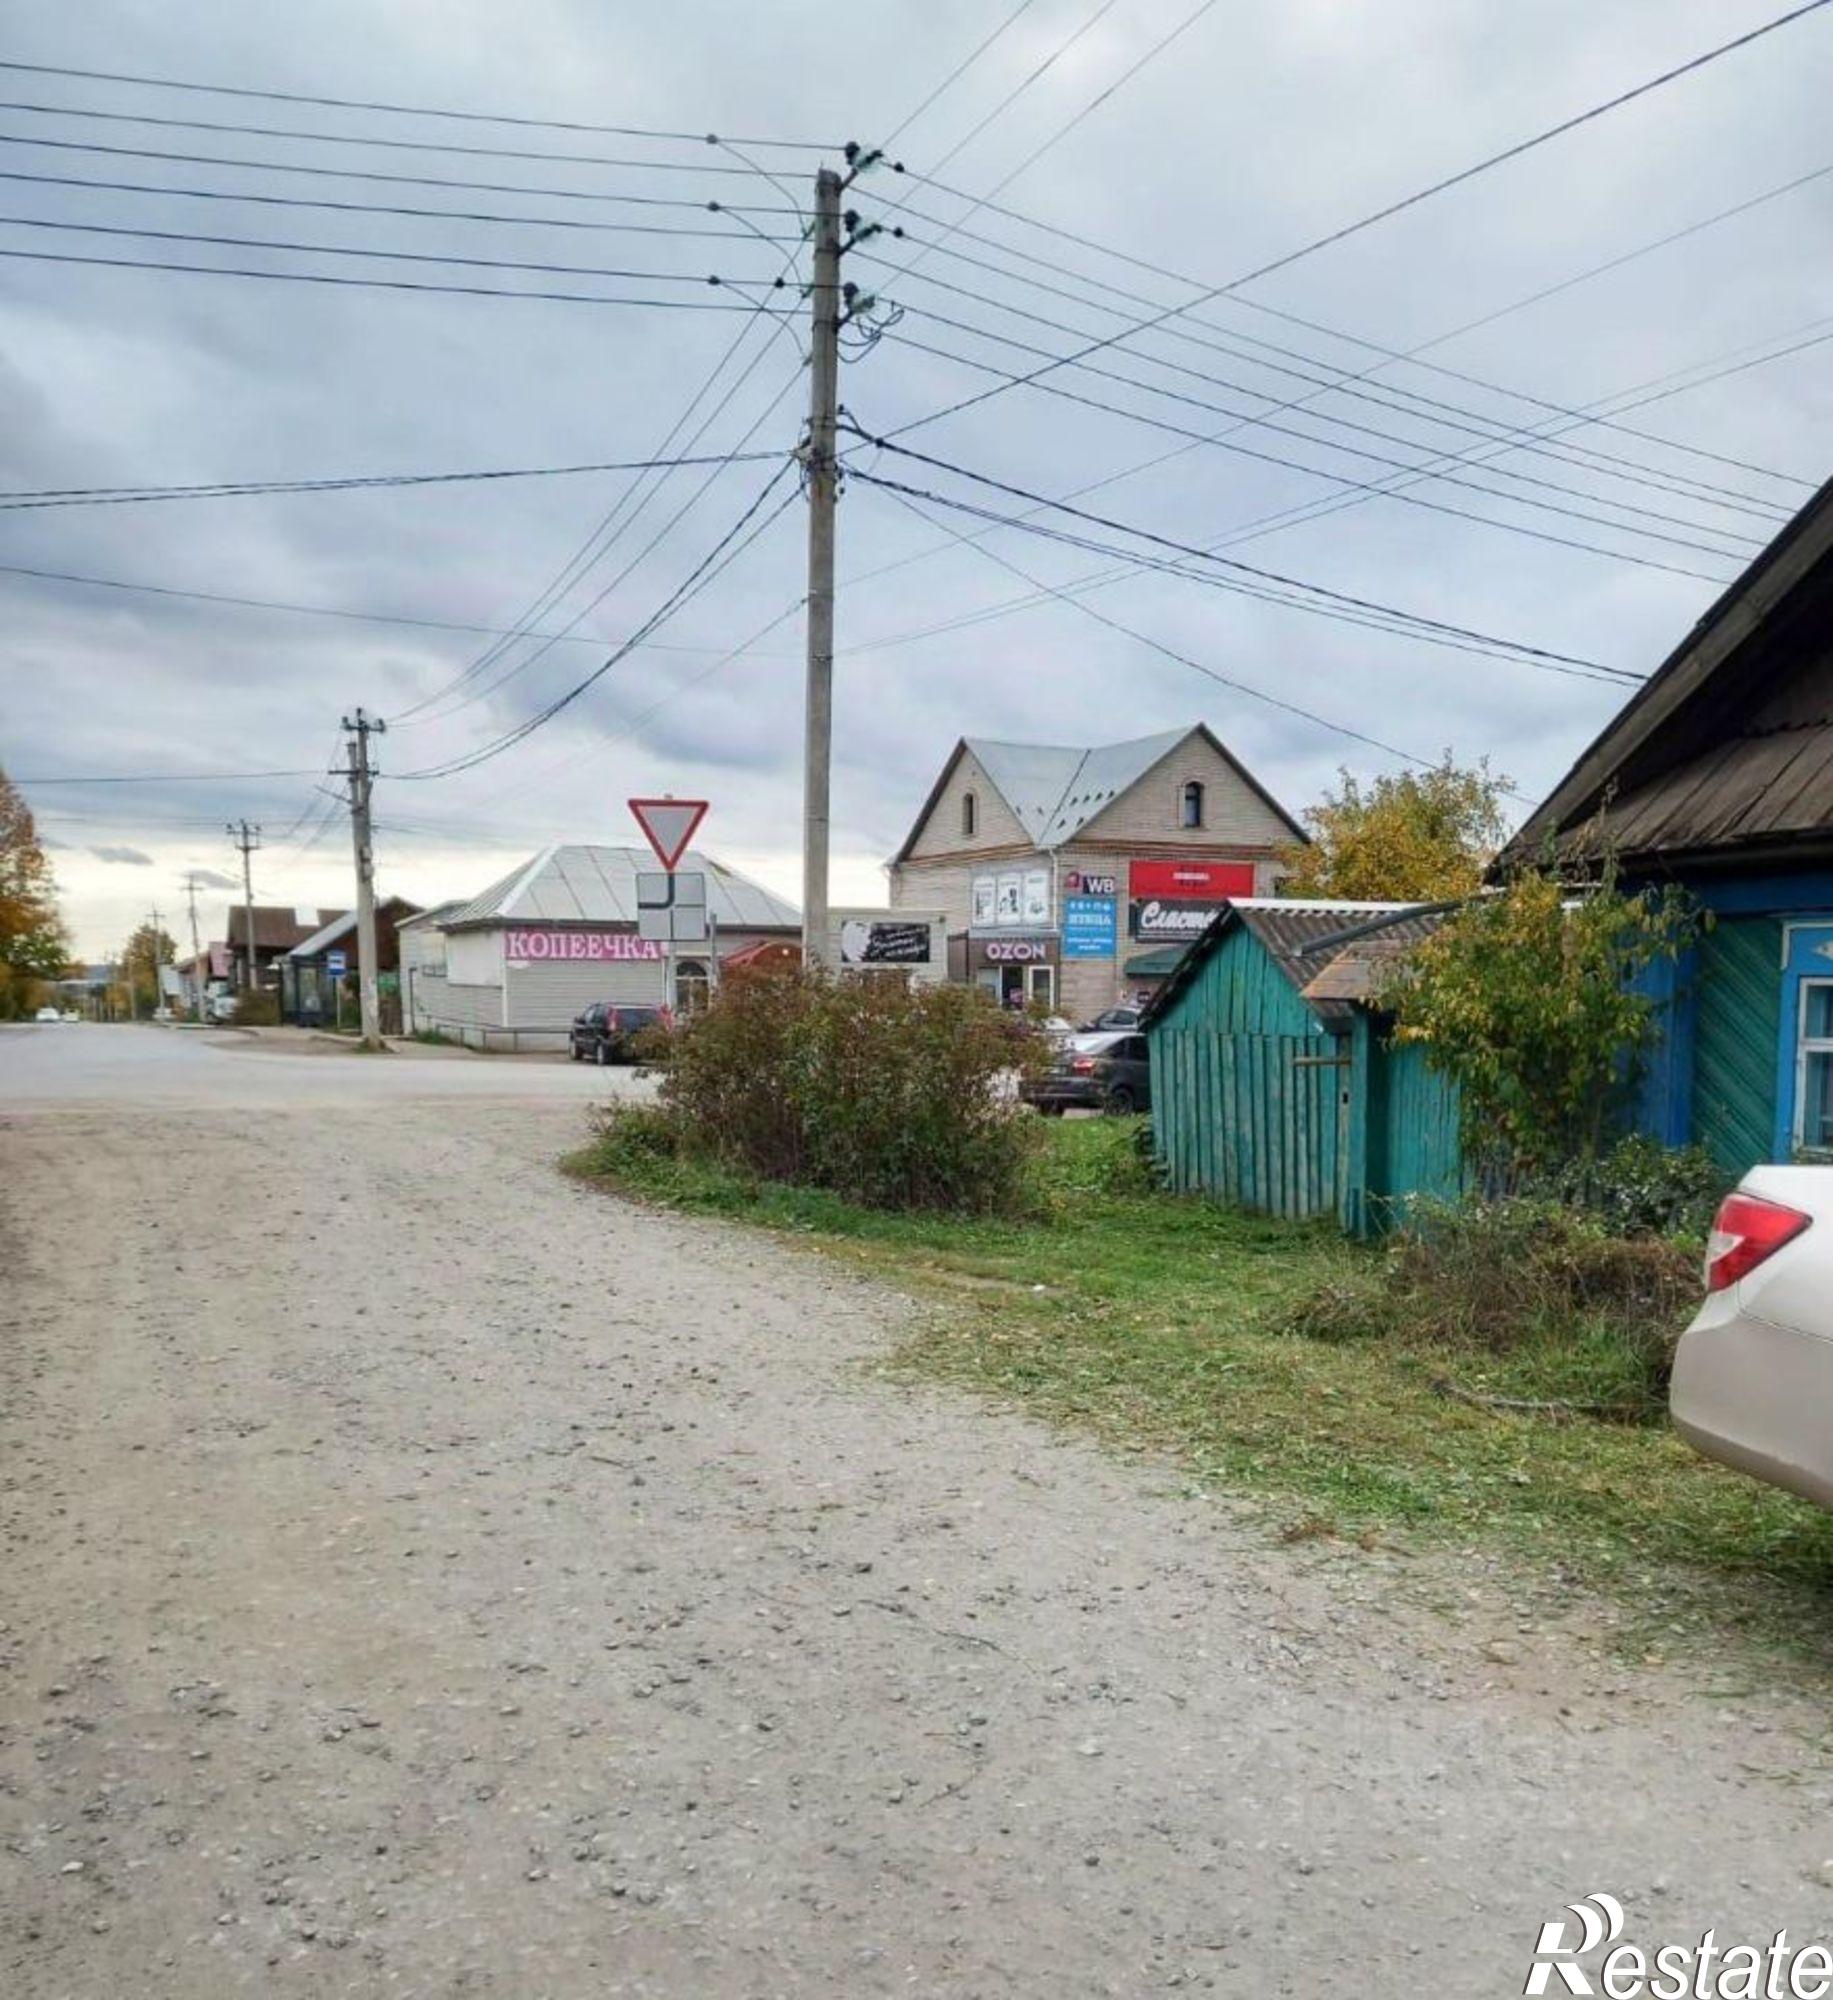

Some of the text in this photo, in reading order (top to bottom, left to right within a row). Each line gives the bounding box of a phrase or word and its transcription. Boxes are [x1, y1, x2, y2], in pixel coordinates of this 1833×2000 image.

[1087, 878, 1114, 893] WB
[508, 932, 658, 959] КОПЕЕЧКА
[986, 943, 1046, 960] OZON
